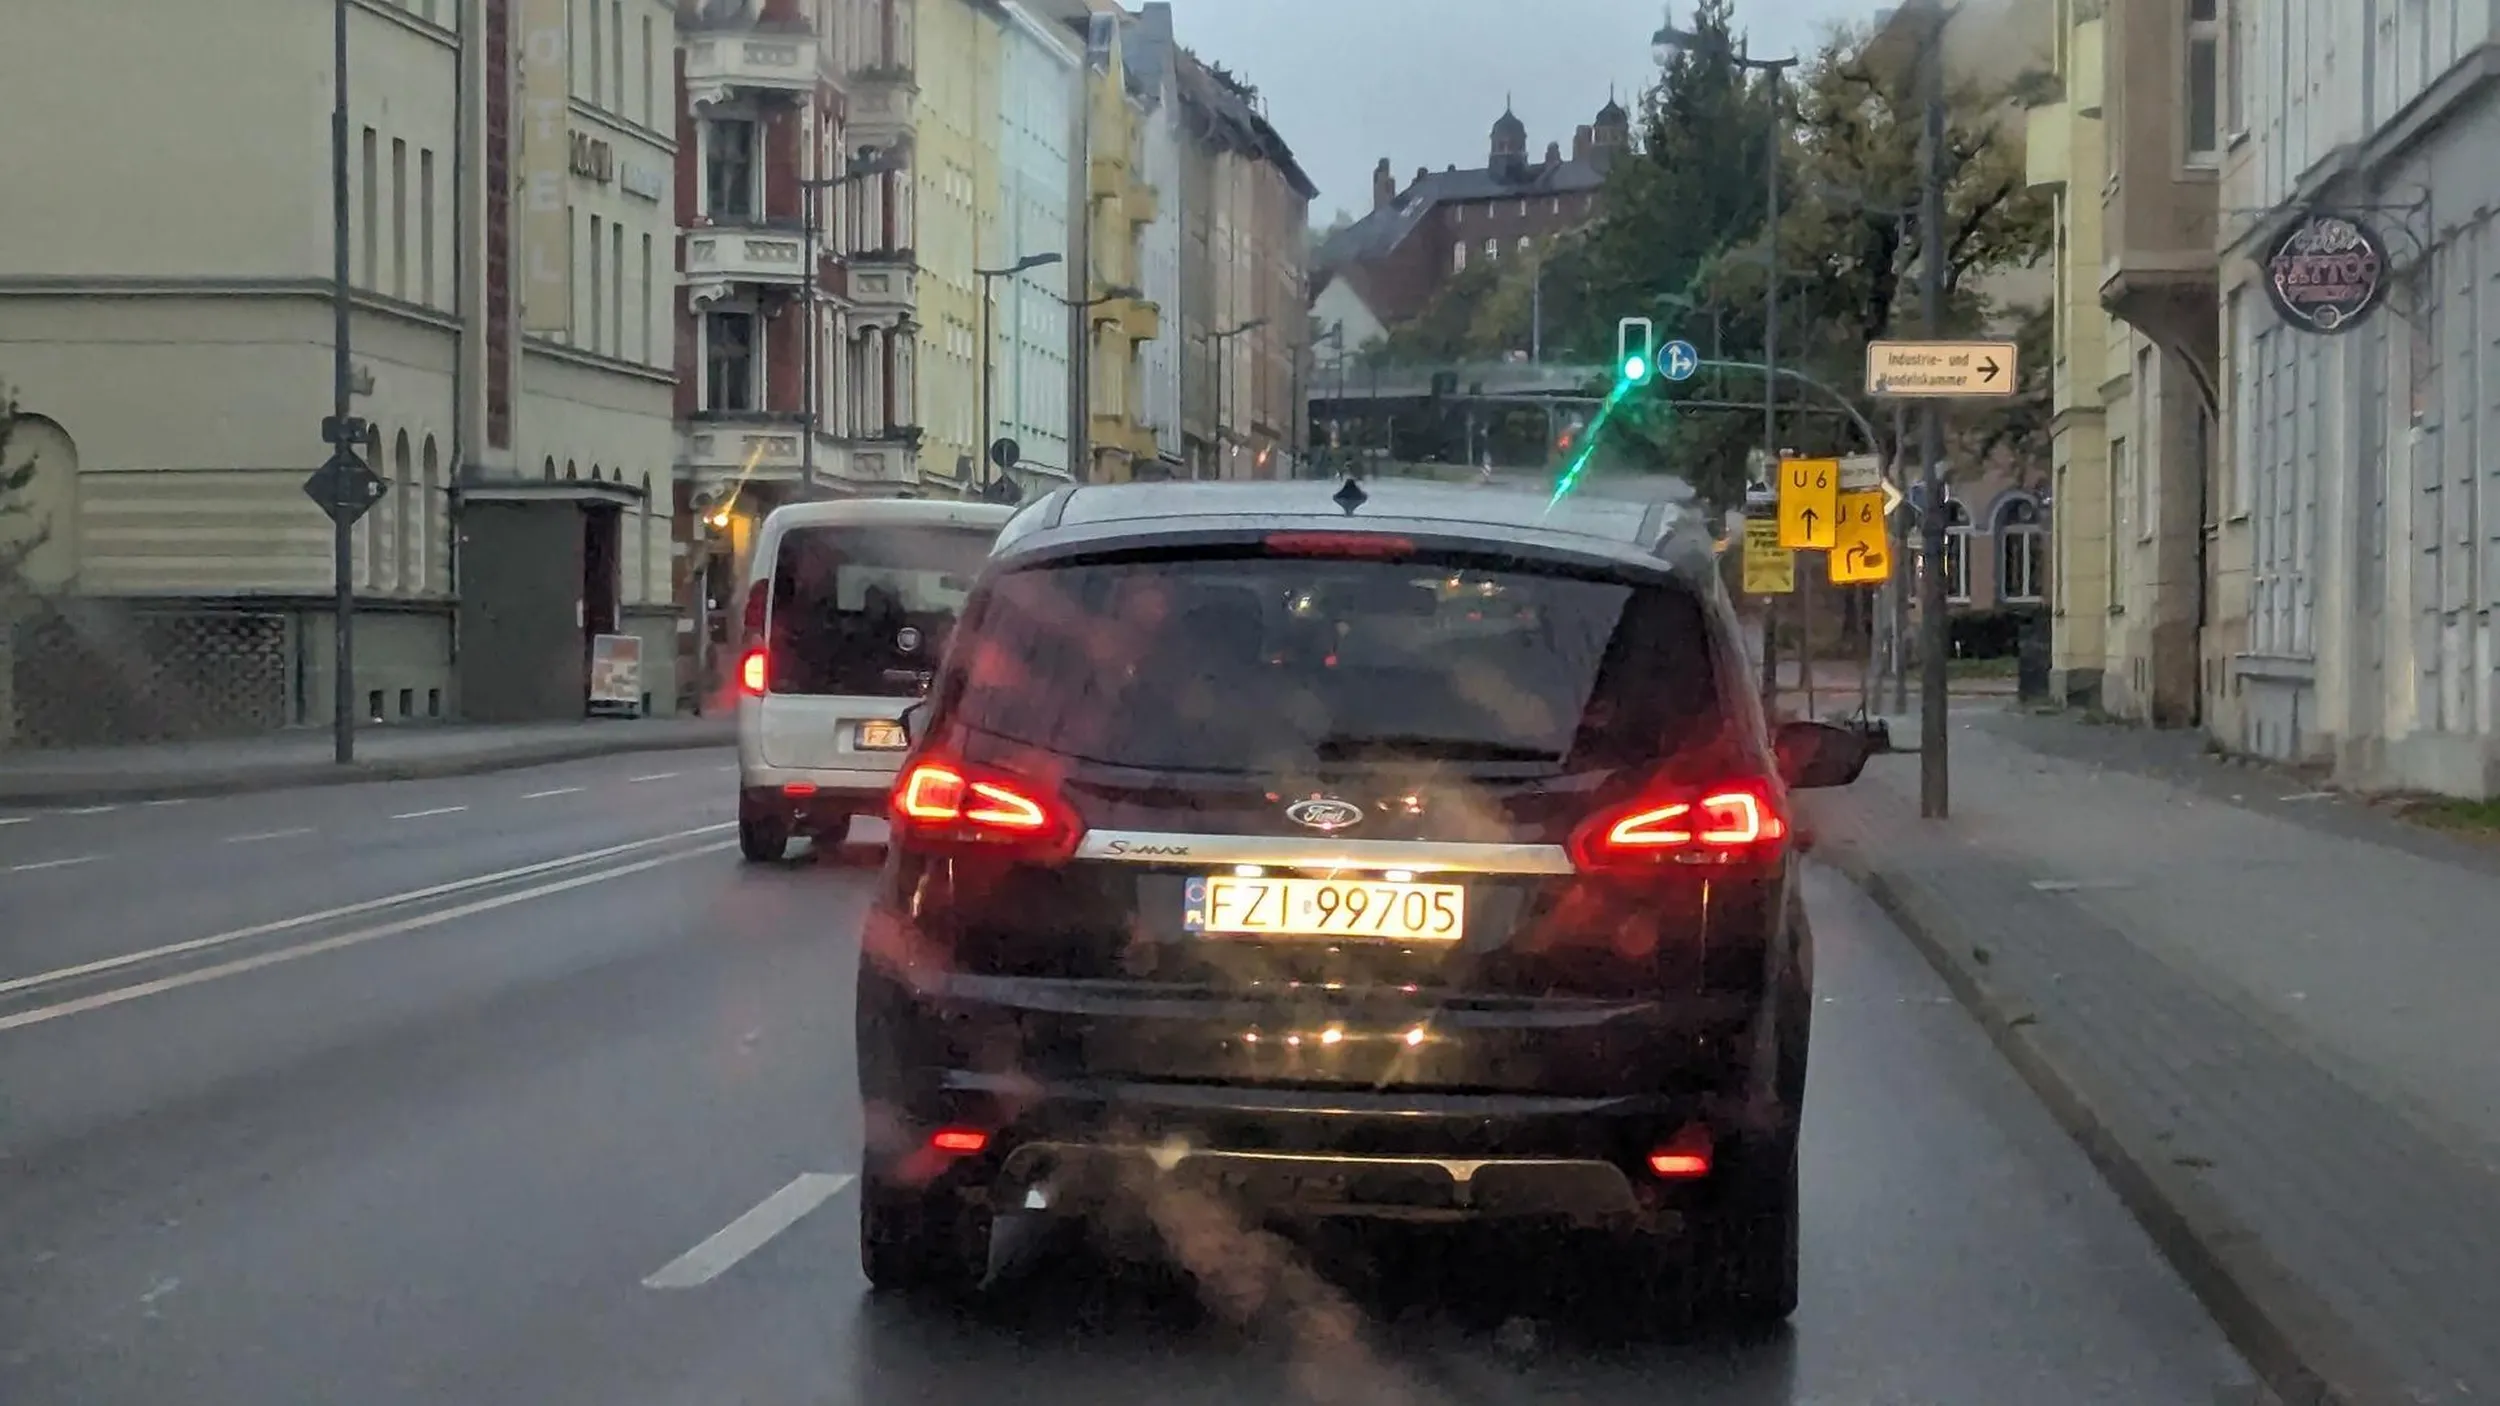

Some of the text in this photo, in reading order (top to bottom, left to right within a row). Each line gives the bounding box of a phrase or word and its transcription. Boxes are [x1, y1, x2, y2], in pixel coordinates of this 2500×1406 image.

[2270, 253, 2380, 285] TATTOO
[1888, 352, 1970, 367] Industrie- und
[1793, 470, 1808, 488] U
[1816, 470, 1827, 489] 6
[1861, 503, 1872, 523] 6
[1304, 805, 1346, 823] Ford
[1211, 884, 1455, 933] FZI 99705
